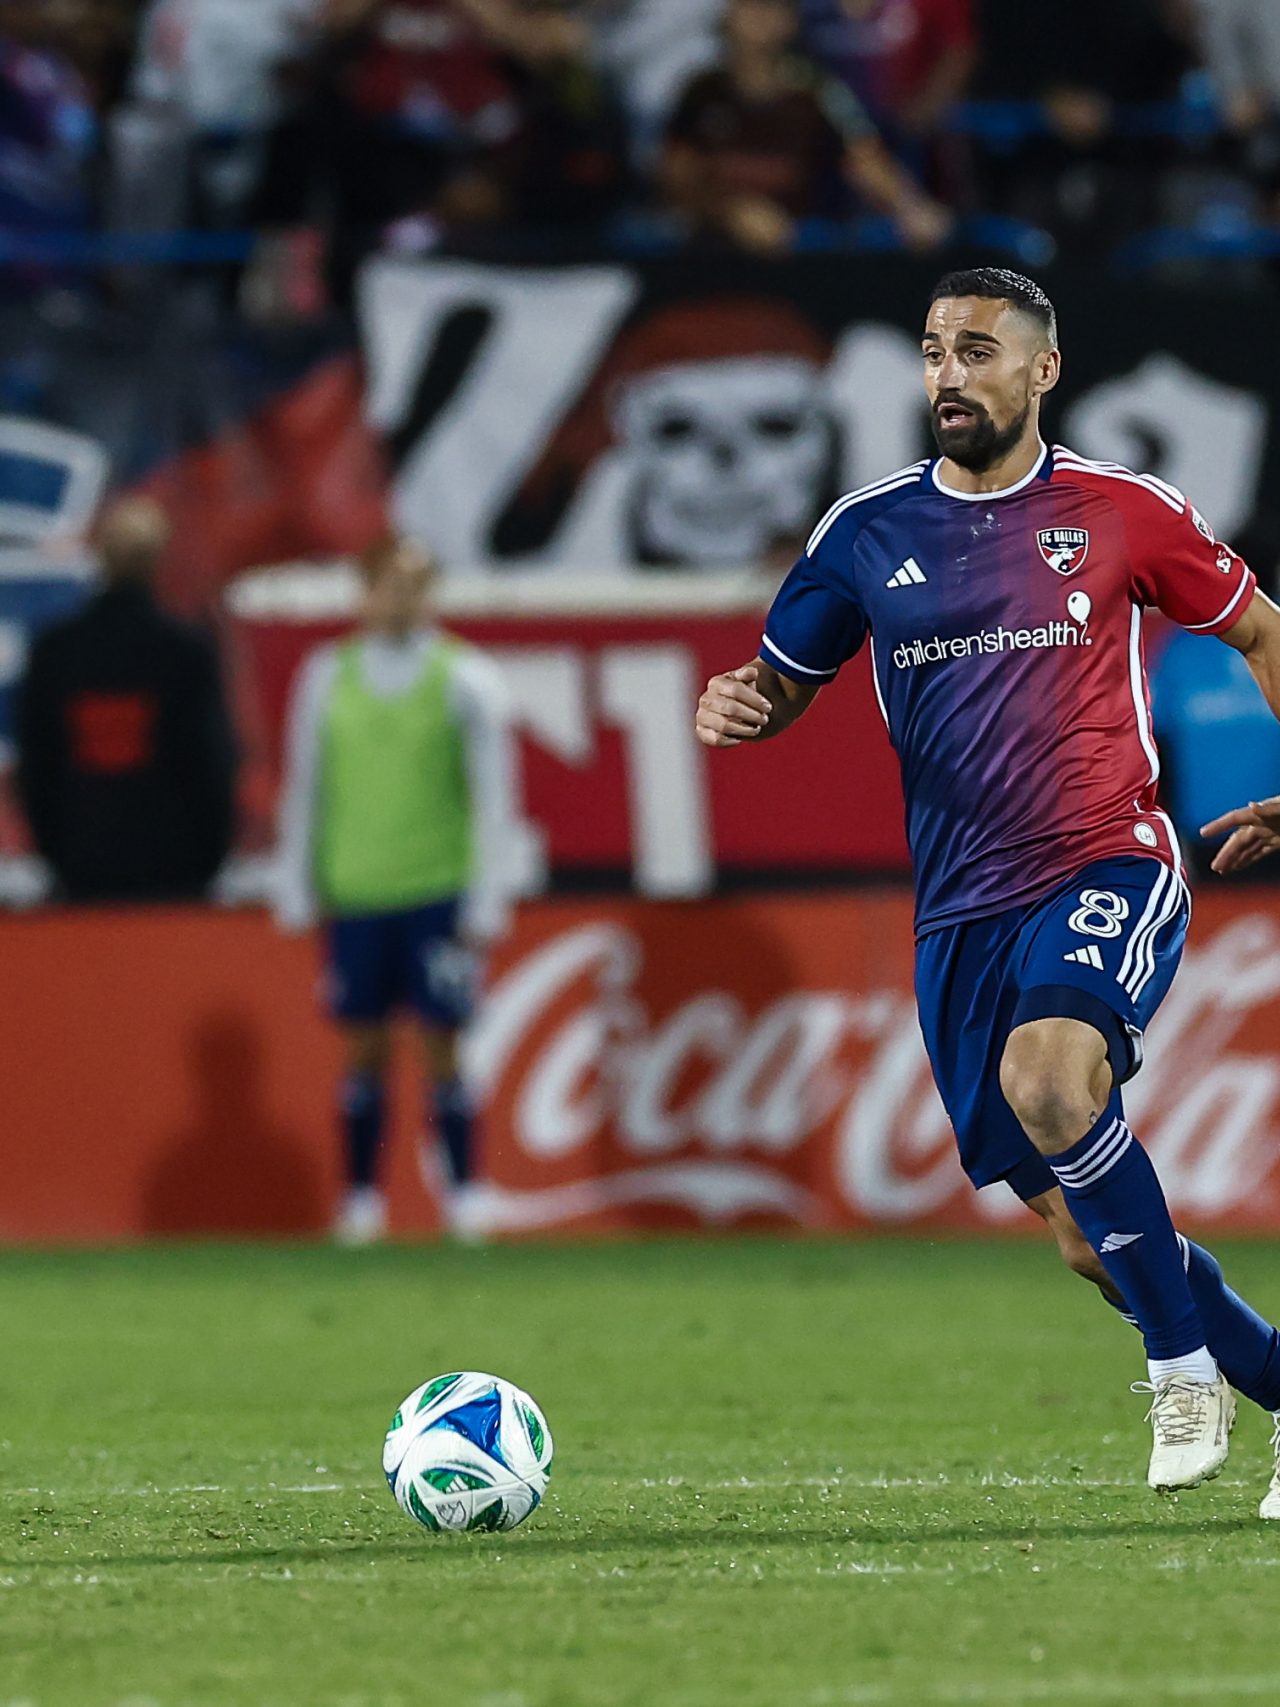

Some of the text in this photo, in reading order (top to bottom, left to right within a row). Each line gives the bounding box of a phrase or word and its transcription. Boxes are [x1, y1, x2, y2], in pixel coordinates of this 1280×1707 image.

[1041, 531, 1084, 544] FC DALLAS
[1068, 889, 1129, 938] 8
